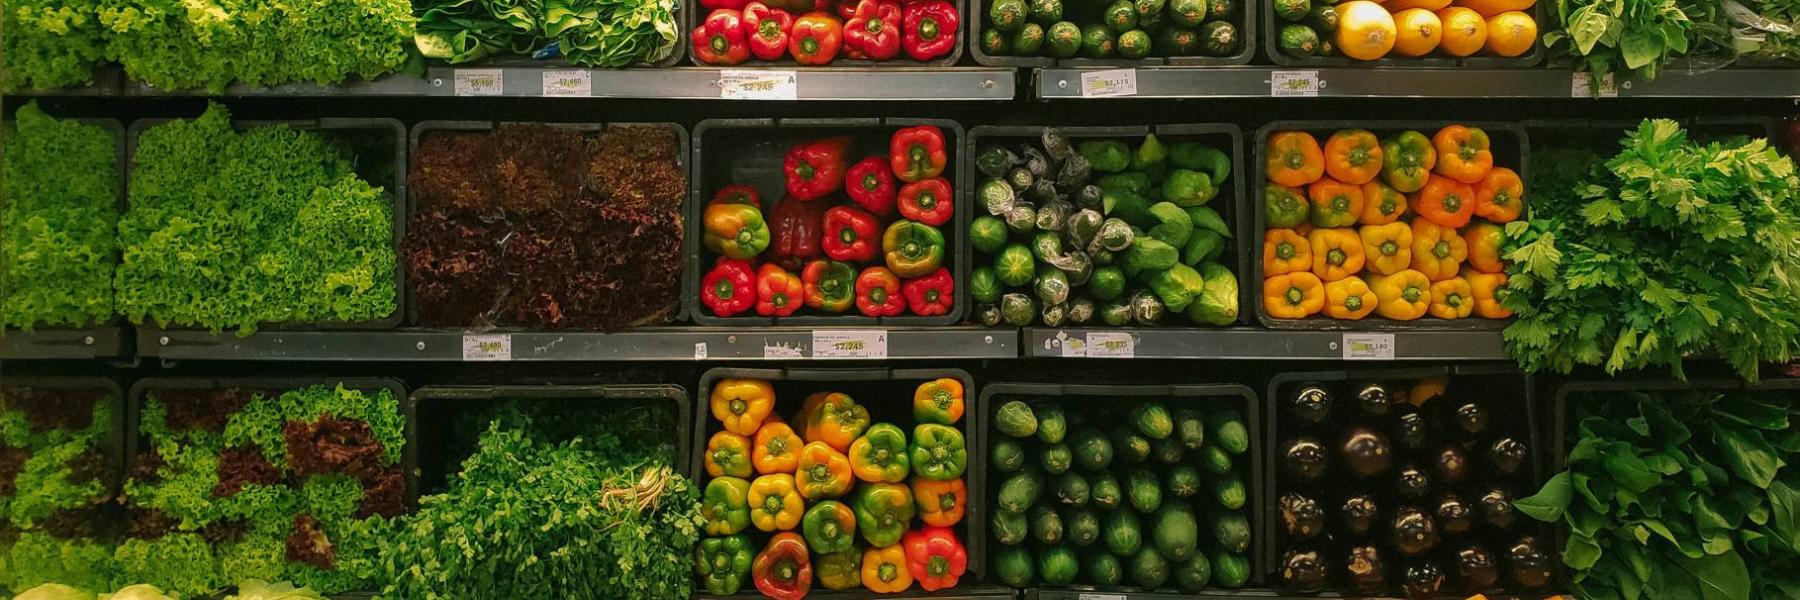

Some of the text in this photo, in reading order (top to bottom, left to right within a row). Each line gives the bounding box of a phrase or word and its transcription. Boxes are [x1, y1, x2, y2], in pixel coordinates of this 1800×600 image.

[788, 75, 795, 84] A
[878, 335, 885, 343] A
[835, 342, 864, 351] $2,245
